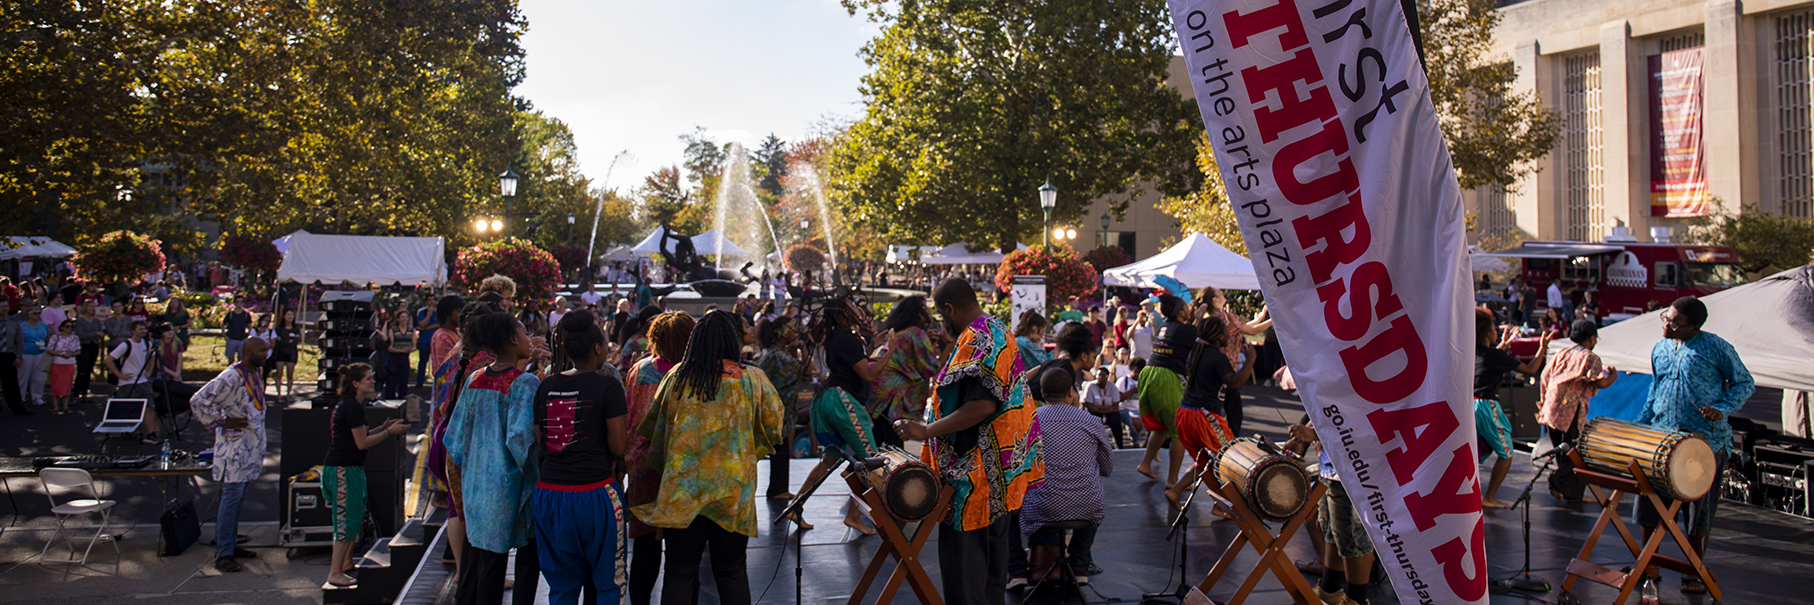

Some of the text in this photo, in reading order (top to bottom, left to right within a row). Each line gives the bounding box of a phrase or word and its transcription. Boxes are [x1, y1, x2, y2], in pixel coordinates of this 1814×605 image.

[1186, 9, 1296, 288] on the arts plaza
[1222, 0, 1488, 602] THURSDAYS
